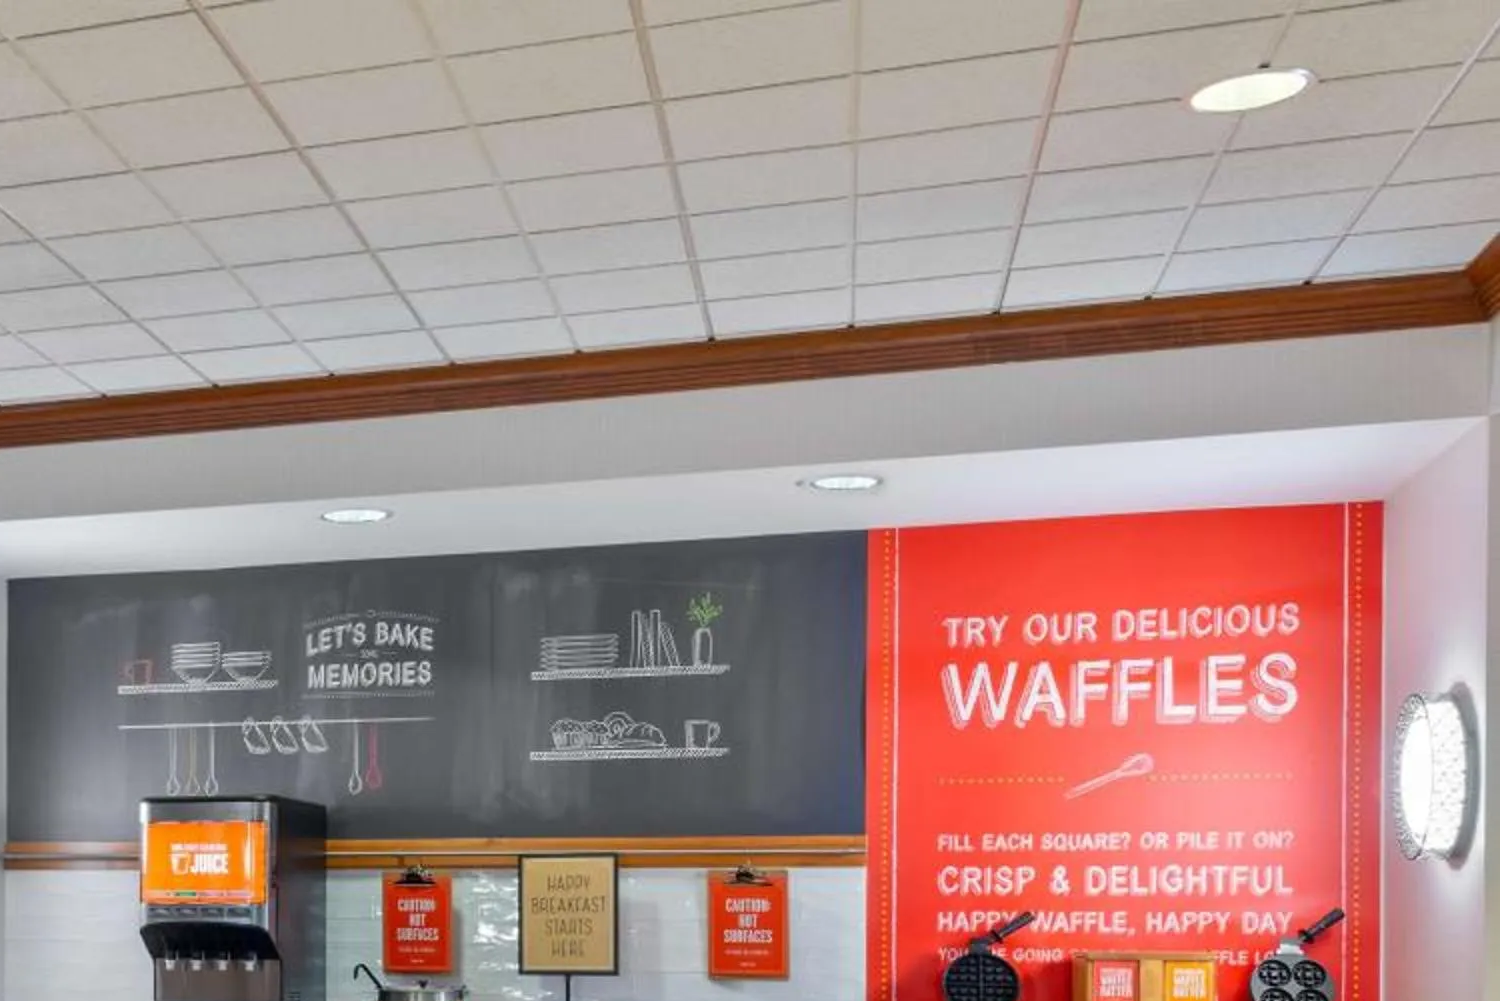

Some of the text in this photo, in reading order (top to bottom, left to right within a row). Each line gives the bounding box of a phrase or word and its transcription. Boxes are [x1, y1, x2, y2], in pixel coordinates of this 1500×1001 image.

[942, 601, 1300, 648] TRY OUR DELICIOUS
[306, 621, 434, 657] LET'S BAKE
[307, 661, 432, 689] MEMORIES
[940, 652, 1299, 729] WAFFLES
[937, 831, 1294, 851] FILL EACH SQUARE? OR PILE IT ON?
[190, 853, 229, 875] JUICE
[547, 873, 591, 892] HAPPY
[937, 864, 1294, 896] CRISP & DELIGHTFUL
[531, 895, 606, 915] BREAKFAST
[937, 910, 1293, 936] HAPPY WAFFLE, HAPPY DAY
[1011, 948, 1064, 964] GOING
